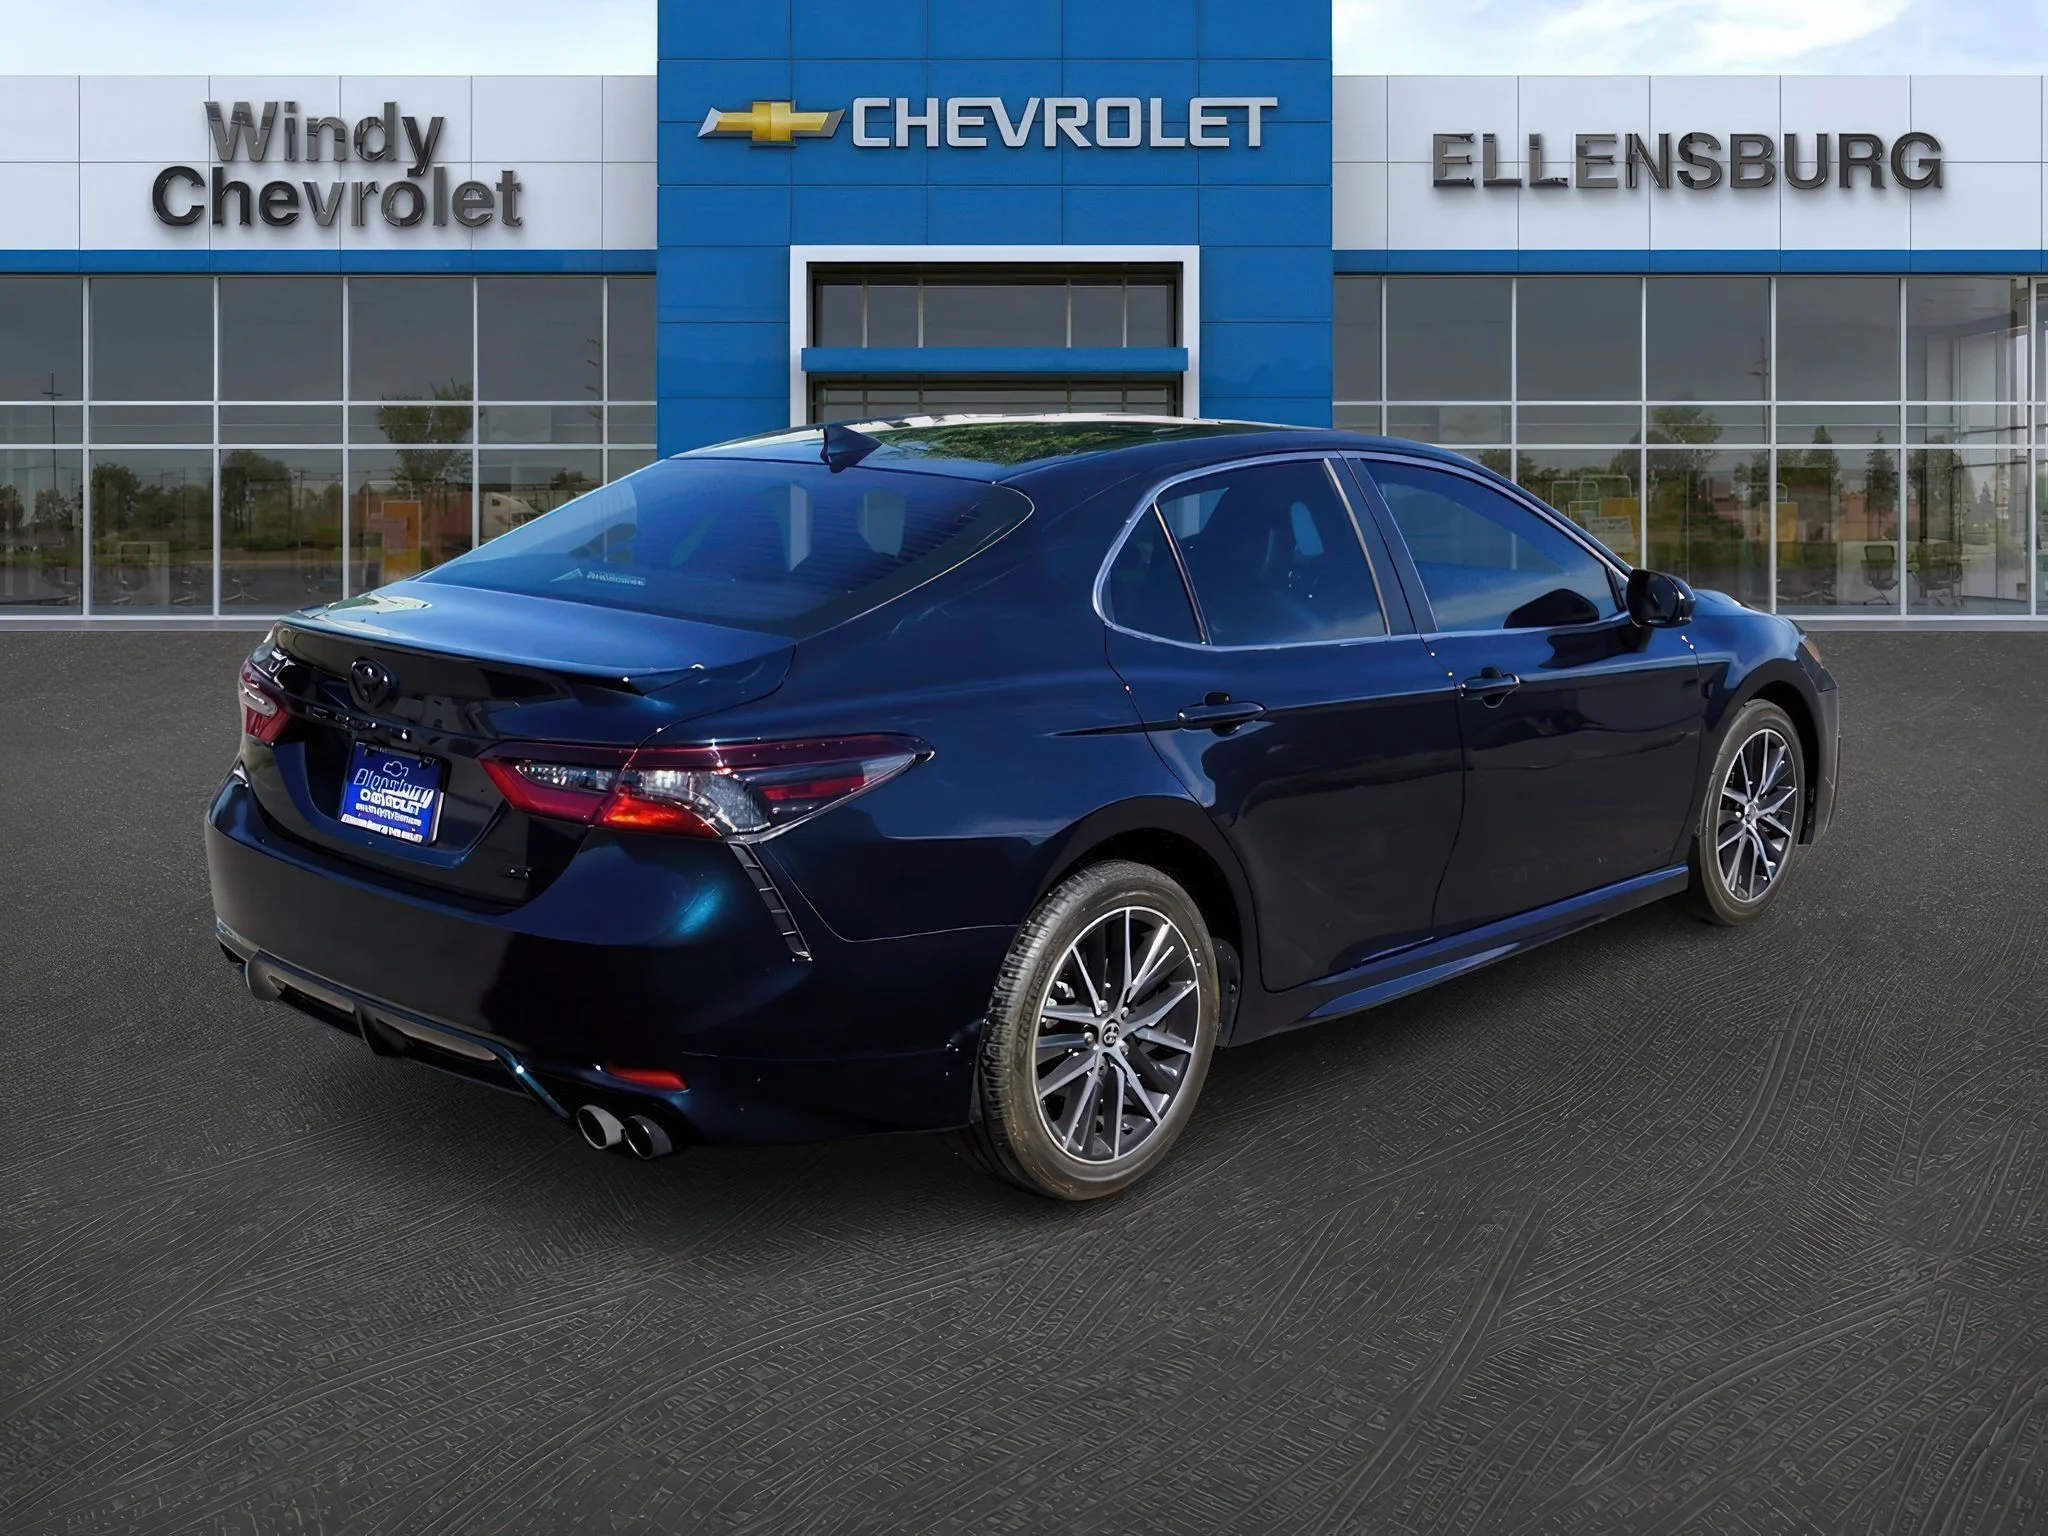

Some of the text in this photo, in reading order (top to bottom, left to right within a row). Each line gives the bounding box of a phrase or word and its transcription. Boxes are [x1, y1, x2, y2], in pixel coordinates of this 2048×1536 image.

[204, 101, 445, 177] Windy
[852, 97, 1278, 147] CHEVROLET
[1432, 132, 1943, 189] ELLENSBURG
[151, 166, 523, 227] Chevrolet
